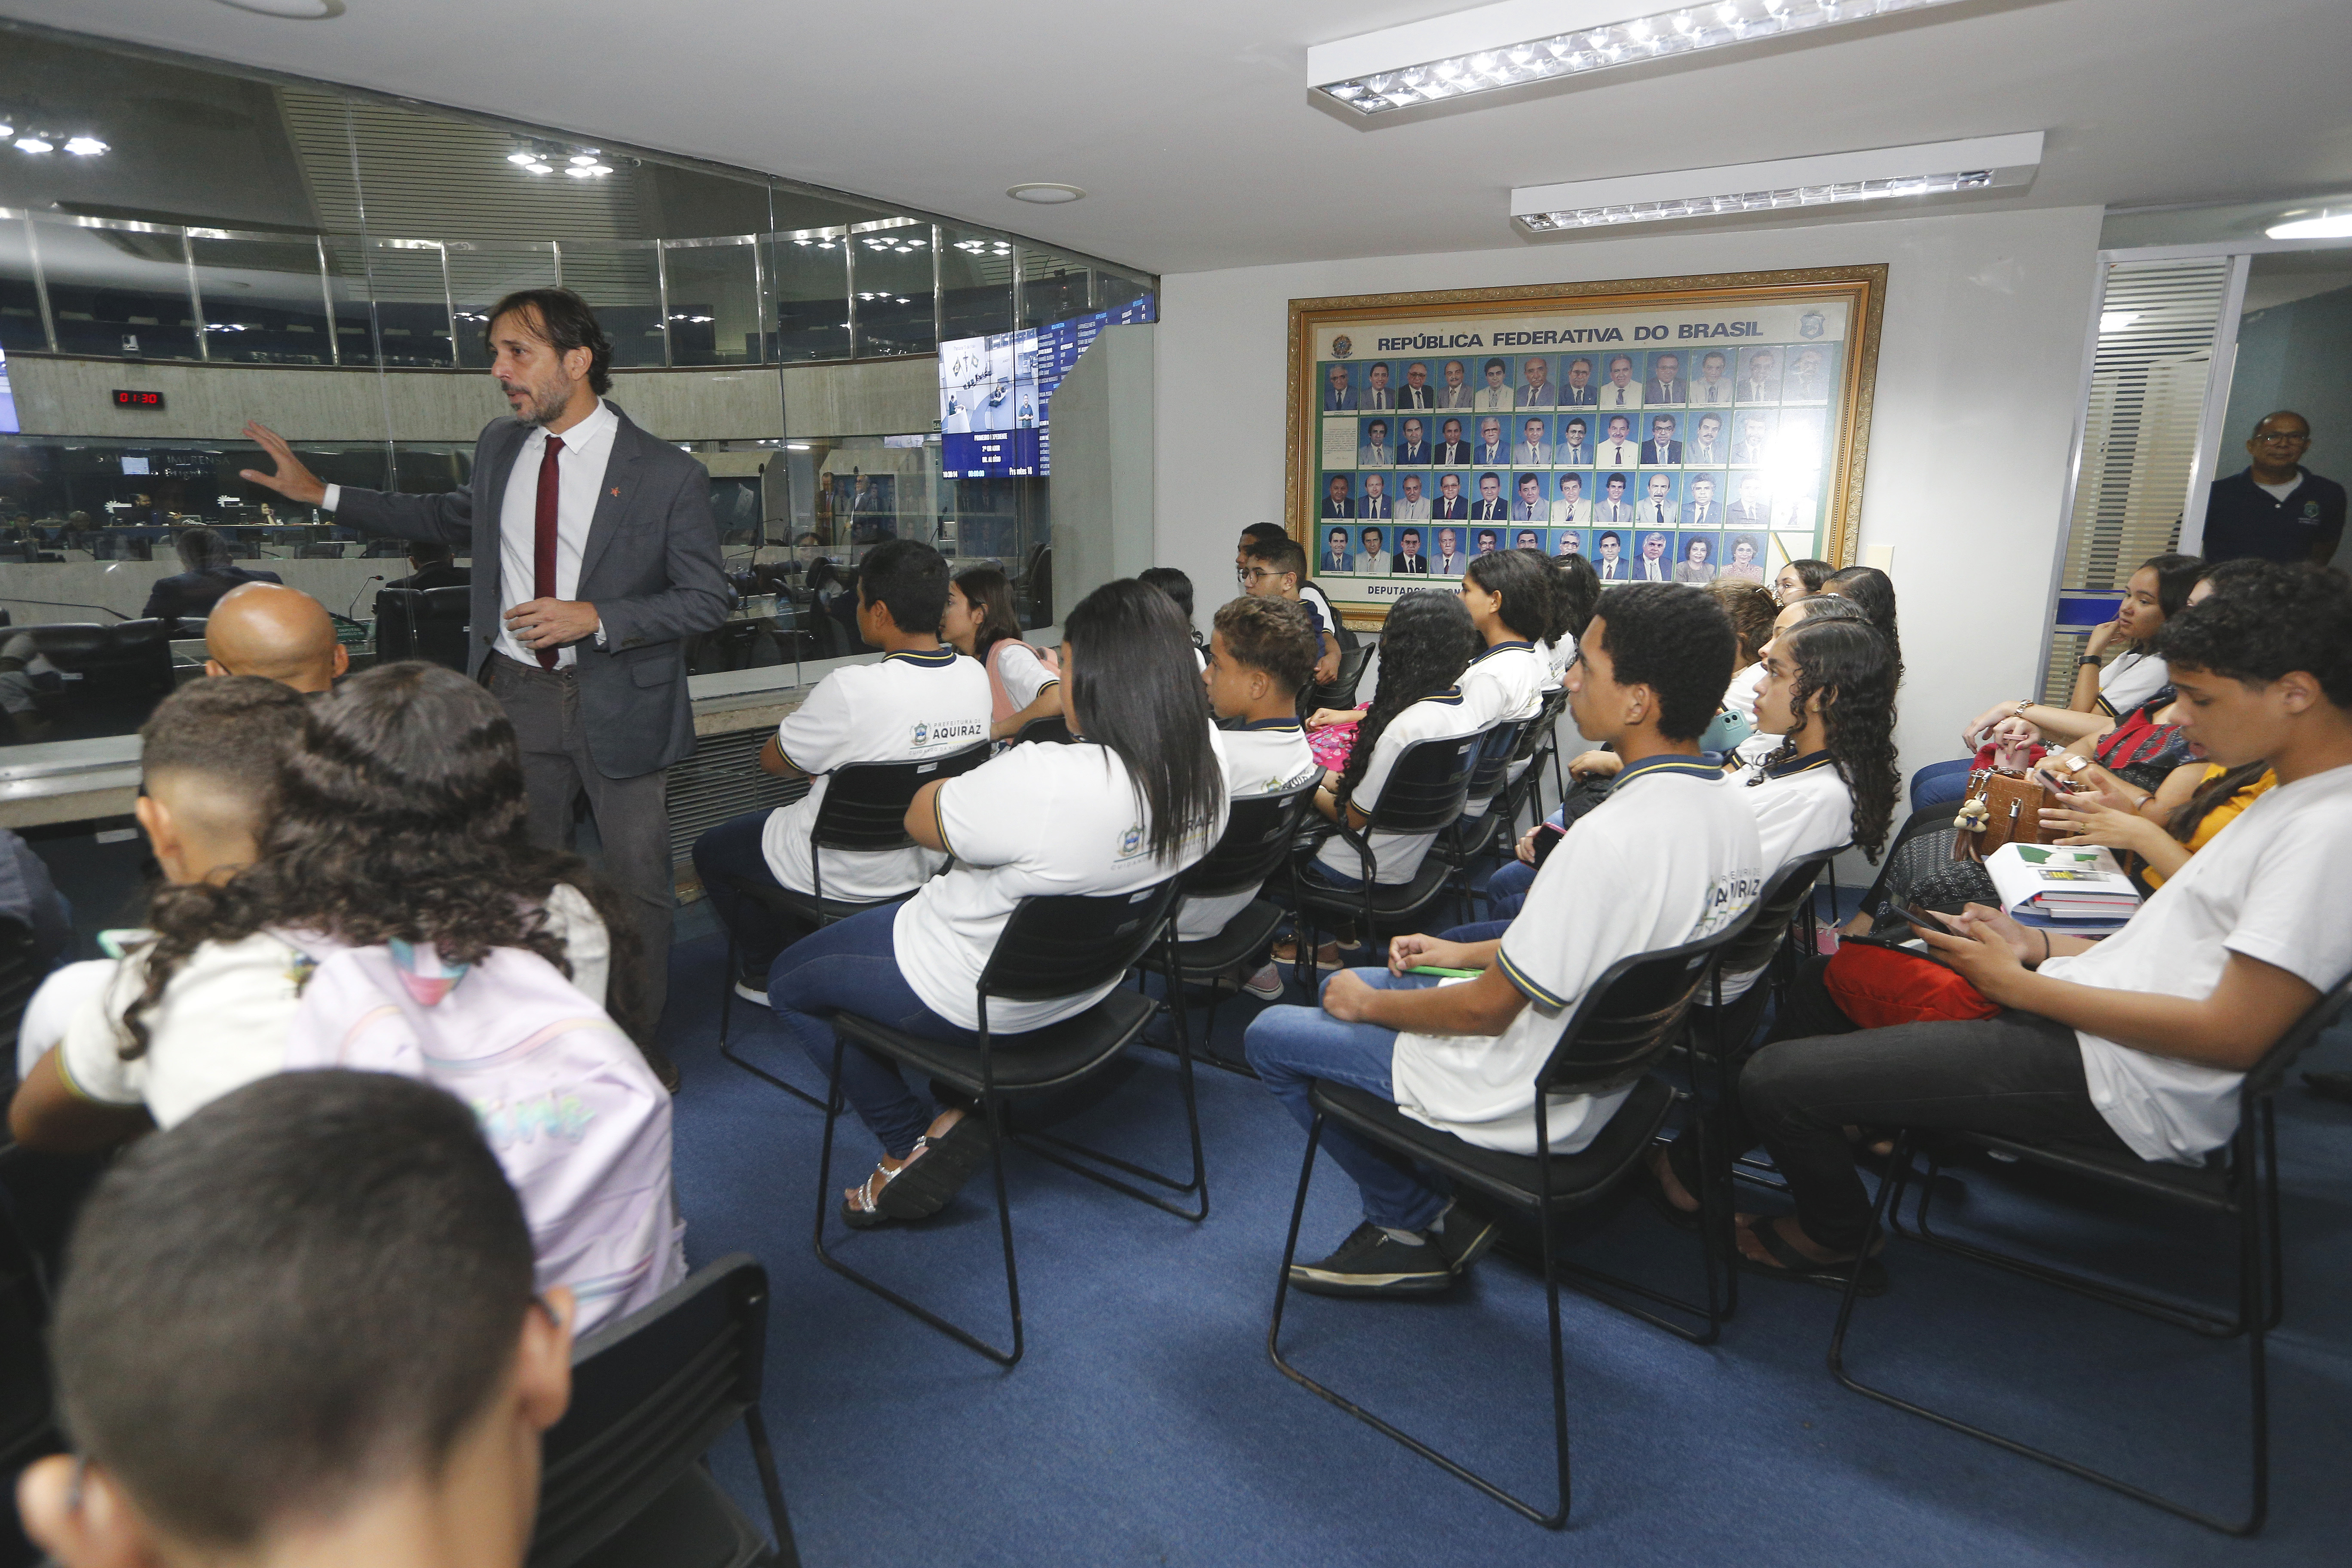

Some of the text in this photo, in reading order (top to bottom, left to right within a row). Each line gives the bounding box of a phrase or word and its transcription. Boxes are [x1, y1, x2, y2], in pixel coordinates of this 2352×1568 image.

[1378, 321, 1763, 351] REPÚBLICA FEDERATIVA DO BRASIL
[119, 392, 157, 404] 01:30
[1368, 586, 1427, 595] DEPUTAD
[932, 725, 981, 739] AQUIRAZ
